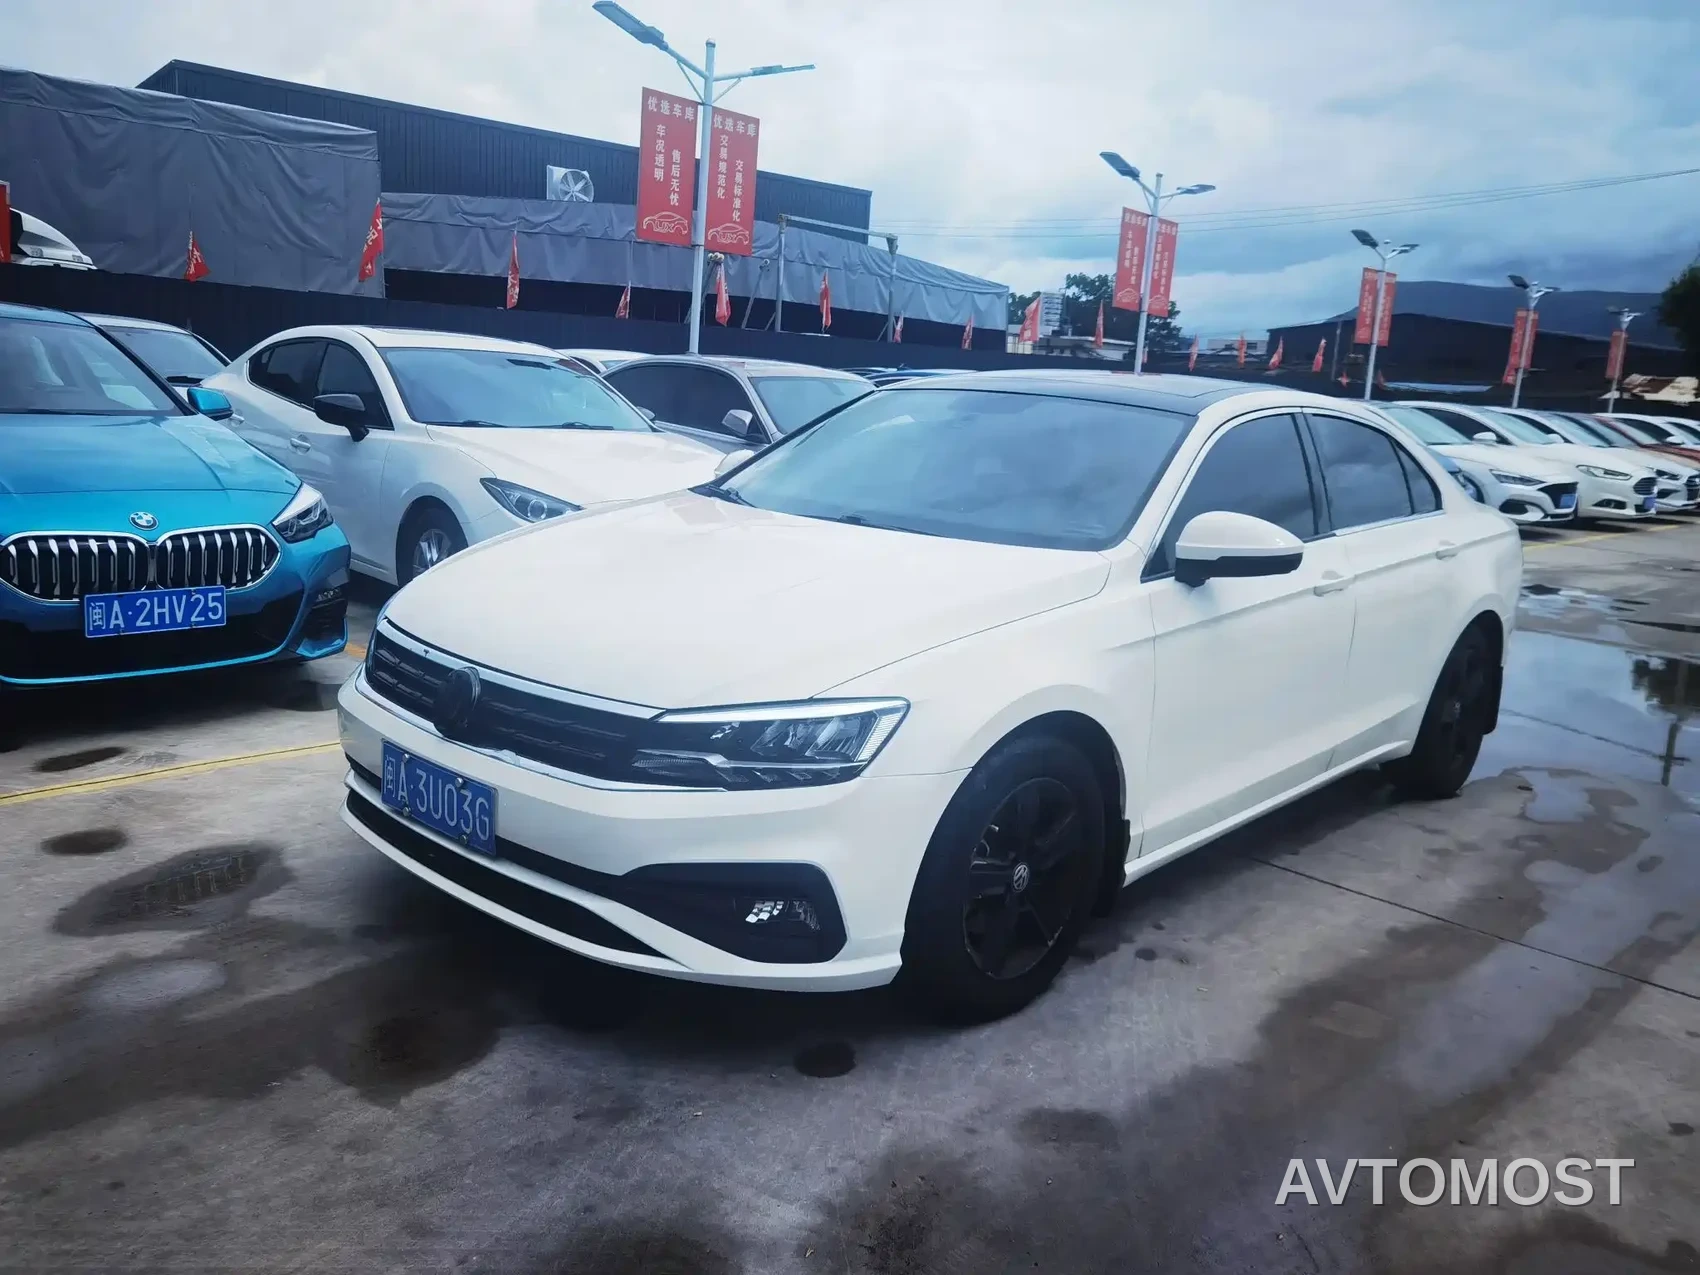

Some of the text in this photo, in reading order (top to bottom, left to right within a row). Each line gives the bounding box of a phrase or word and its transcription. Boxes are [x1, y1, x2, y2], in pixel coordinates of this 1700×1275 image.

[647, 96, 695, 122] 优选车库
[713, 114, 757, 137] 优选车库
[654, 124, 667, 182] 车况透明
[669, 149, 681, 206] 售后无忧
[716, 134, 729, 199] 交易规范化
[732, 159, 744, 222] 交易标准化
